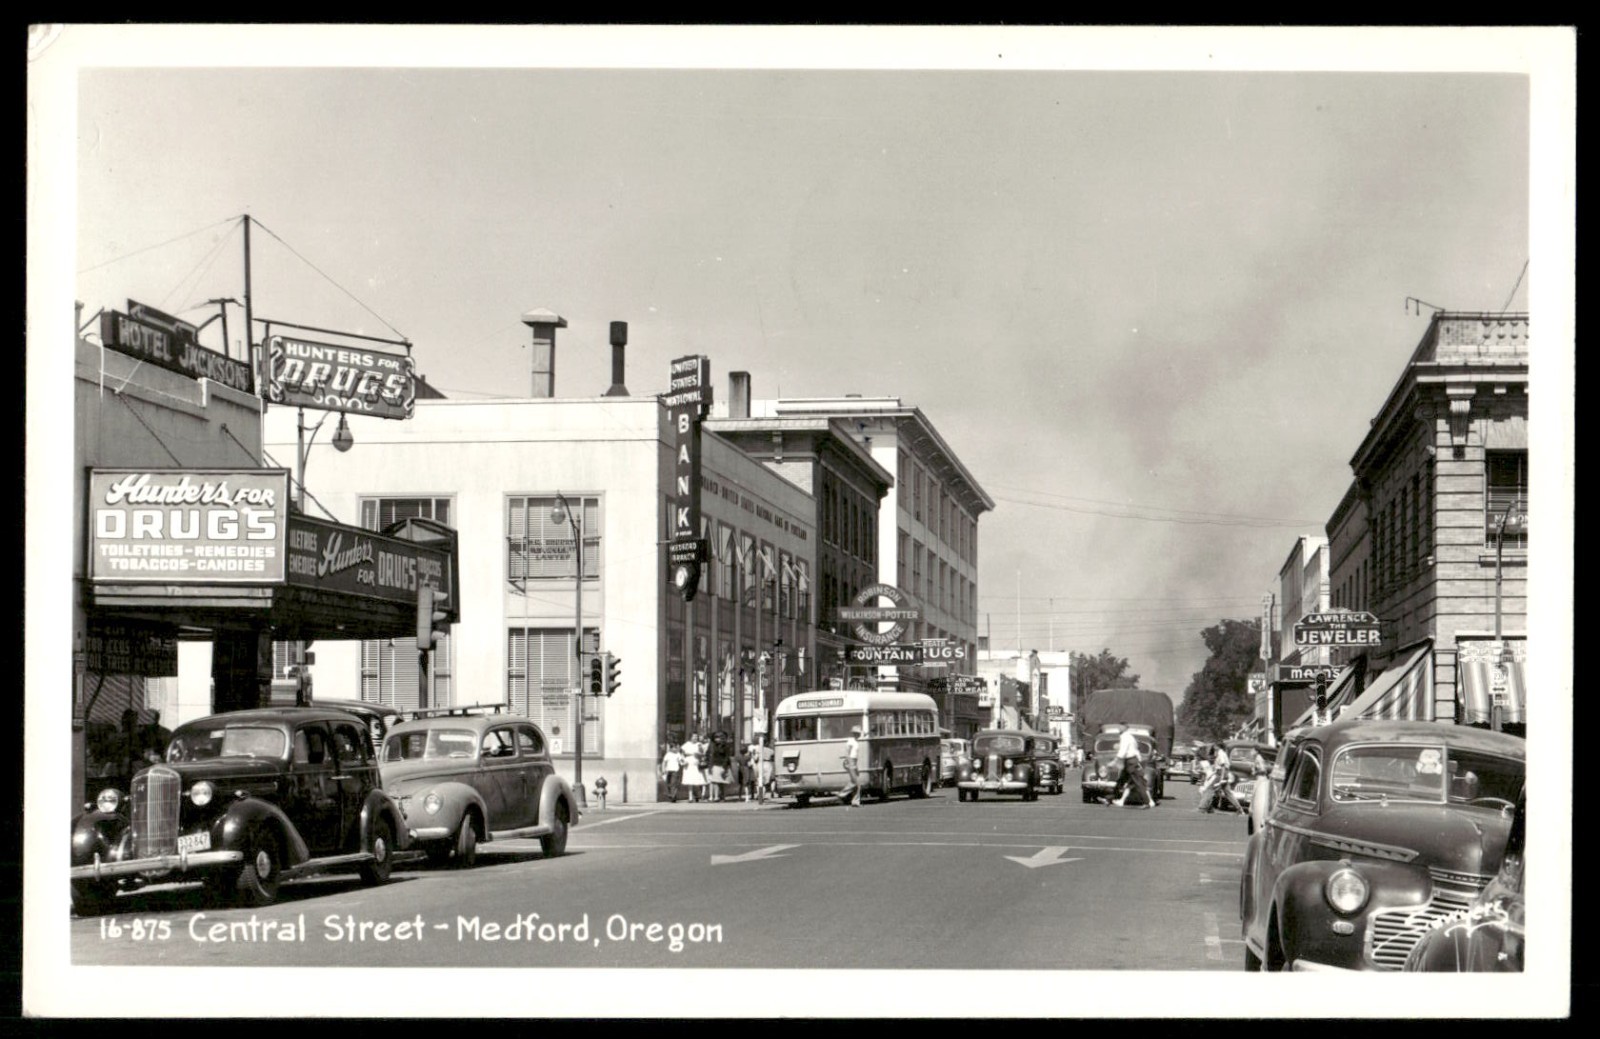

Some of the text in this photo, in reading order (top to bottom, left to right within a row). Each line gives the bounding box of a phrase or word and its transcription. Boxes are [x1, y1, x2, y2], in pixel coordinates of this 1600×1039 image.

[118, 316, 249, 391] HOTEL JACKSON
[286, 342, 400, 371] HUNTERS FOR
[277, 357, 407, 400] DRUGS
[678, 413, 690, 528] BANK
[235, 488, 275, 507] FOR
[96, 508, 277, 540] DRUGS
[357, 551, 417, 591] FOR DRUGS
[857, 583, 902, 604] ROBINSON
[1308, 613, 1367, 623] LAWRENCE
[855, 624, 905, 646] INSURANCE
[1297, 630, 1381, 644] JEWELER
[852, 650, 914, 660] FOUNTAIN
